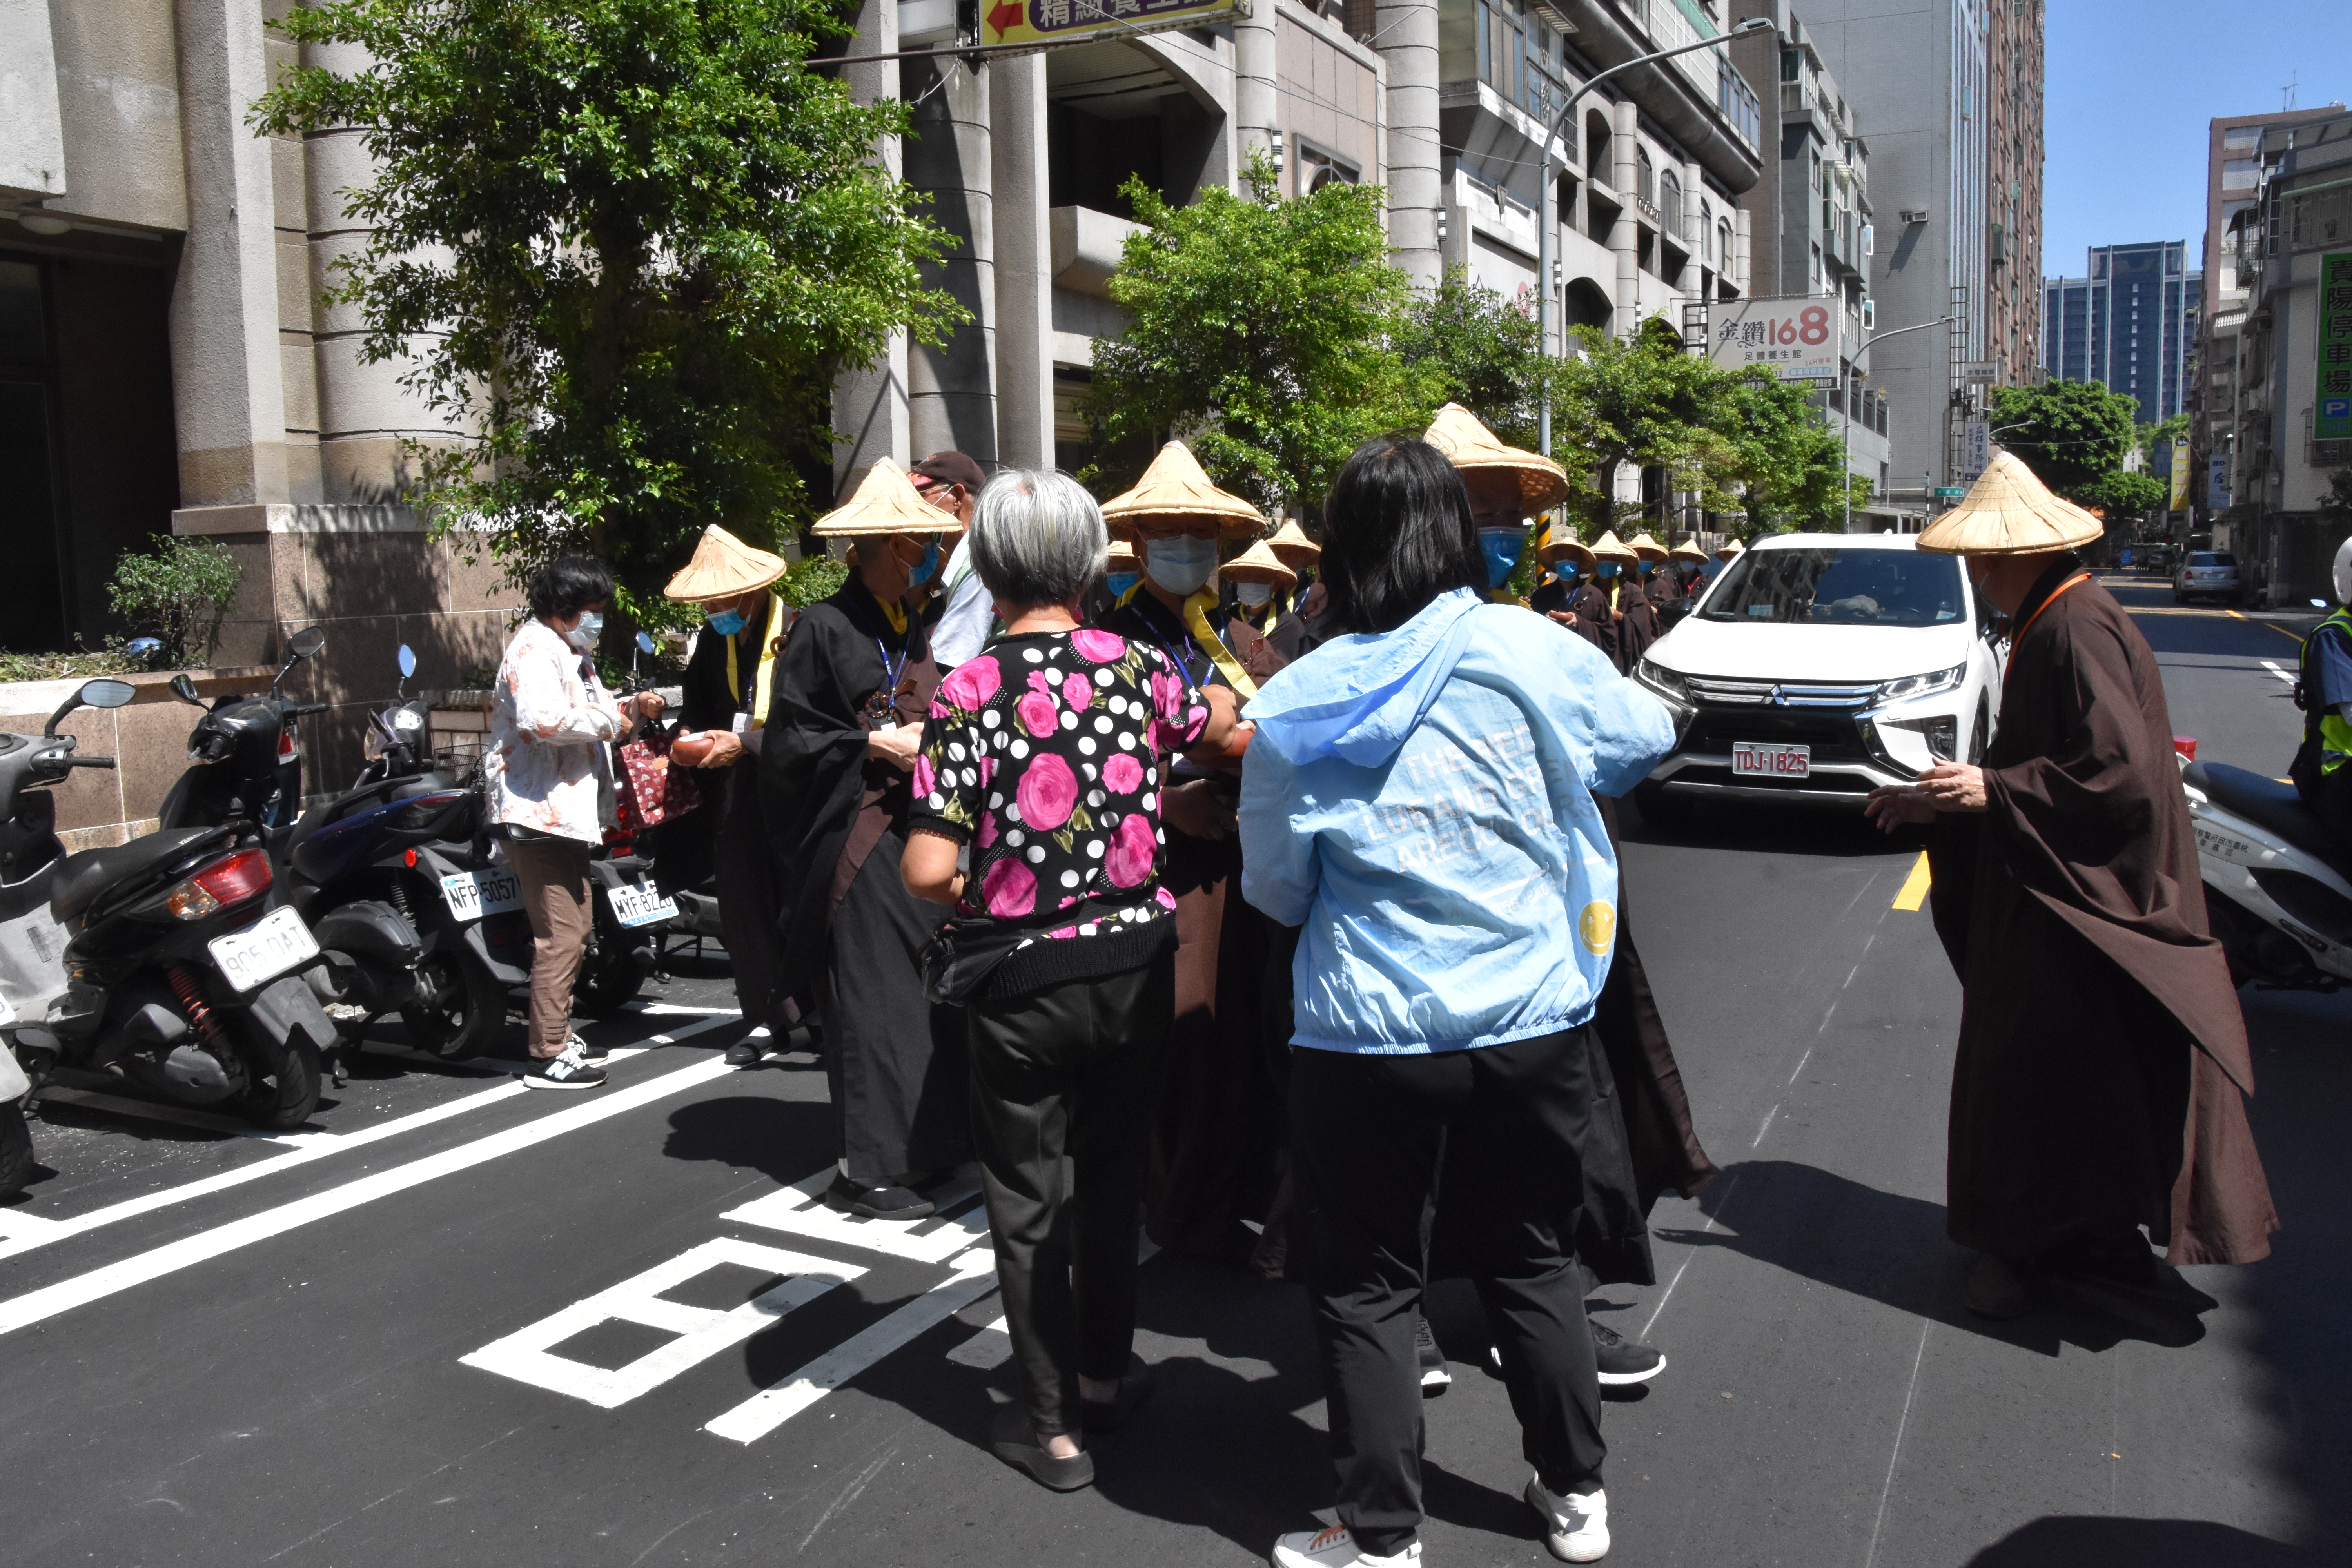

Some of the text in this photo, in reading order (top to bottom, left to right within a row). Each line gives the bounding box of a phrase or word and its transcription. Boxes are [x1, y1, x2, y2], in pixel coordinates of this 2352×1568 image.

[1744, 350, 1802, 361] 足體養生館
[1398, 744, 1471, 783] THE
